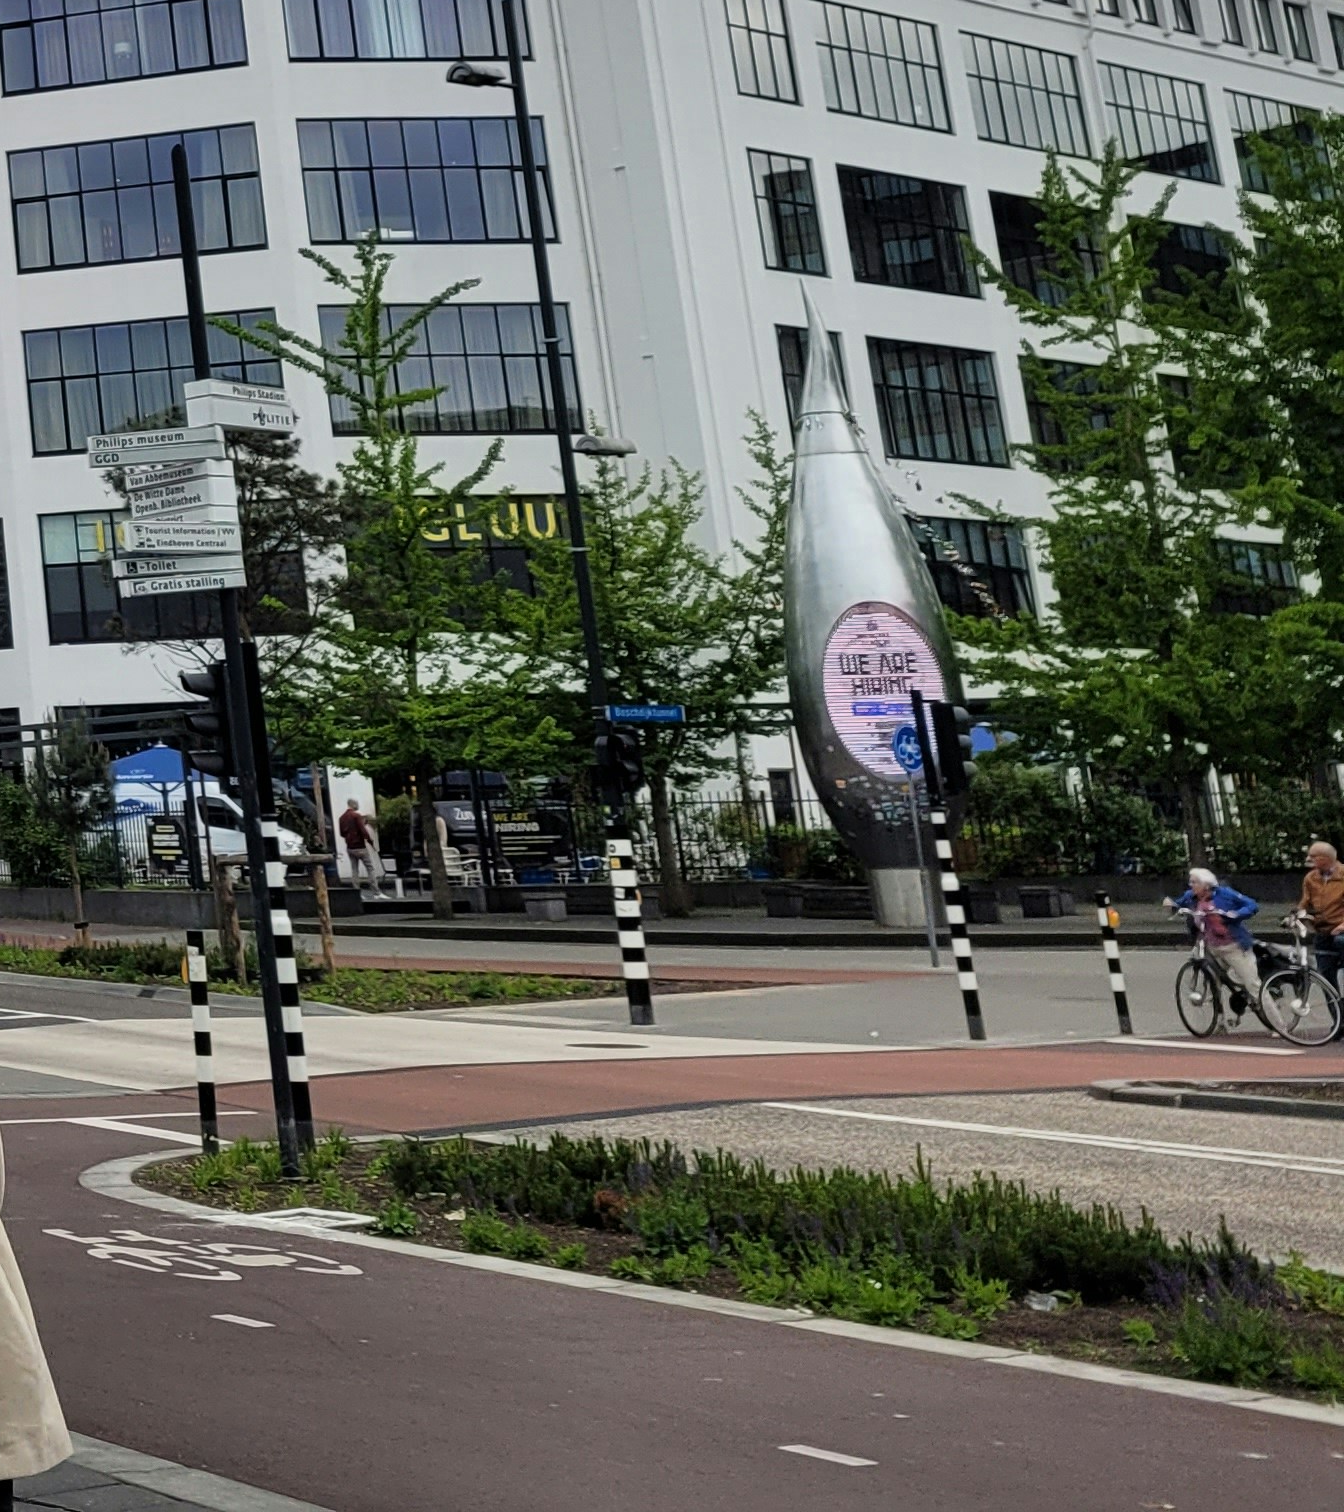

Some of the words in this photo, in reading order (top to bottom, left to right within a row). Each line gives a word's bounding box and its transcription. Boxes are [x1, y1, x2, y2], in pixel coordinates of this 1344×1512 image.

[95, 436, 134, 449] Philips
[137, 432, 185, 445] museum
[94, 453, 120, 464] GGD
[129, 476, 144, 486] Van
[145, 468, 194, 482] Abbemuseum
[134, 493, 144, 502] De
[145, 488, 164, 500] Witte
[165, 486, 185, 496] Dame
[160, 493, 202, 508] Bibliotheek
[145, 527, 171, 535] Tourist
[172, 527, 216, 536] Information
[156, 539, 194, 547] Eindhoven
[196, 539, 227, 547] Centraal
[150, 580, 183, 591] Gratis
[185, 576, 226, 589] stalling
[839, 653, 871, 675] WE
